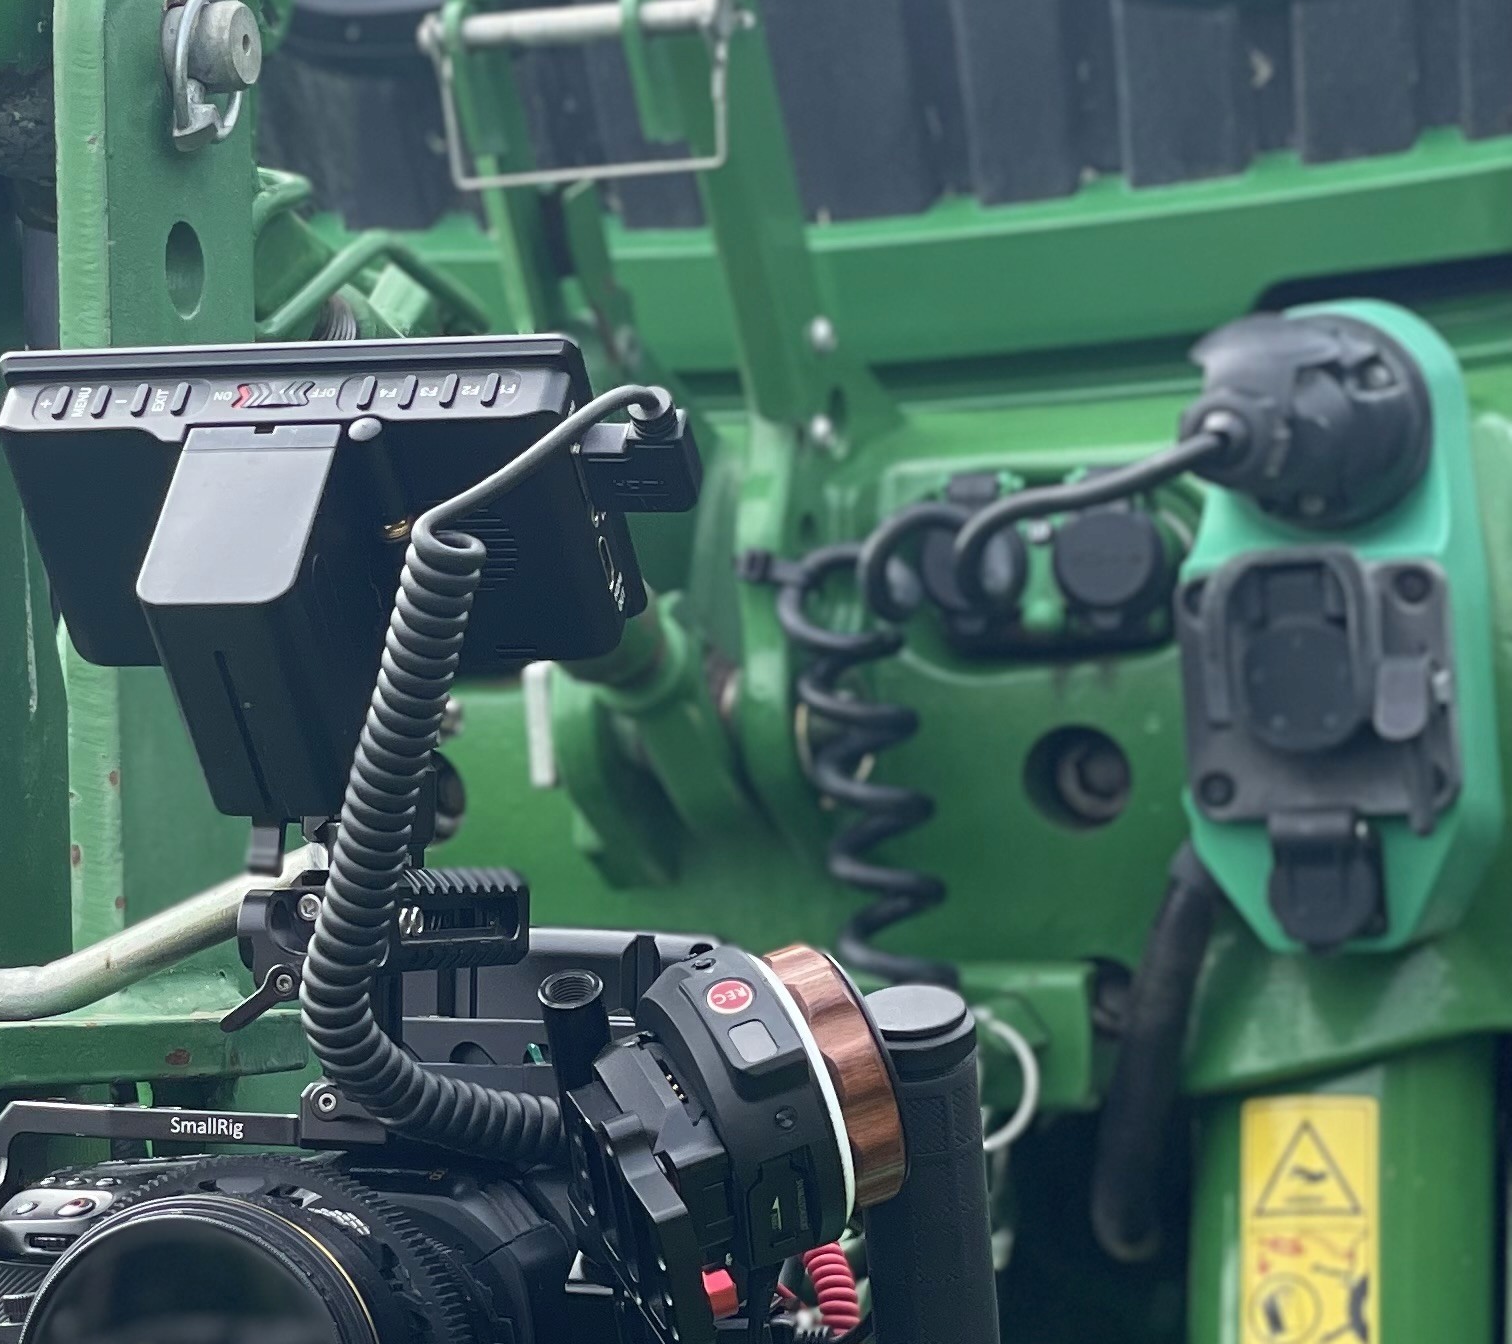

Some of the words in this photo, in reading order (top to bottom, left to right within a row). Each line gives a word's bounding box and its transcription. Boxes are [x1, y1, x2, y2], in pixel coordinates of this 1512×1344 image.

[310, 387, 336, 398] OFF
[379, 387, 397, 398] F4
[419, 386, 438, 397] F3
[461, 385, 480, 396] F2
[499, 383, 517, 394] F1
[152, 388, 170, 412] EXIT
[213, 391, 233, 401] ON
[71, 387, 92, 418] MENU
[712, 986, 747, 1005] REC
[170, 1116, 244, 1140] SmallRig
